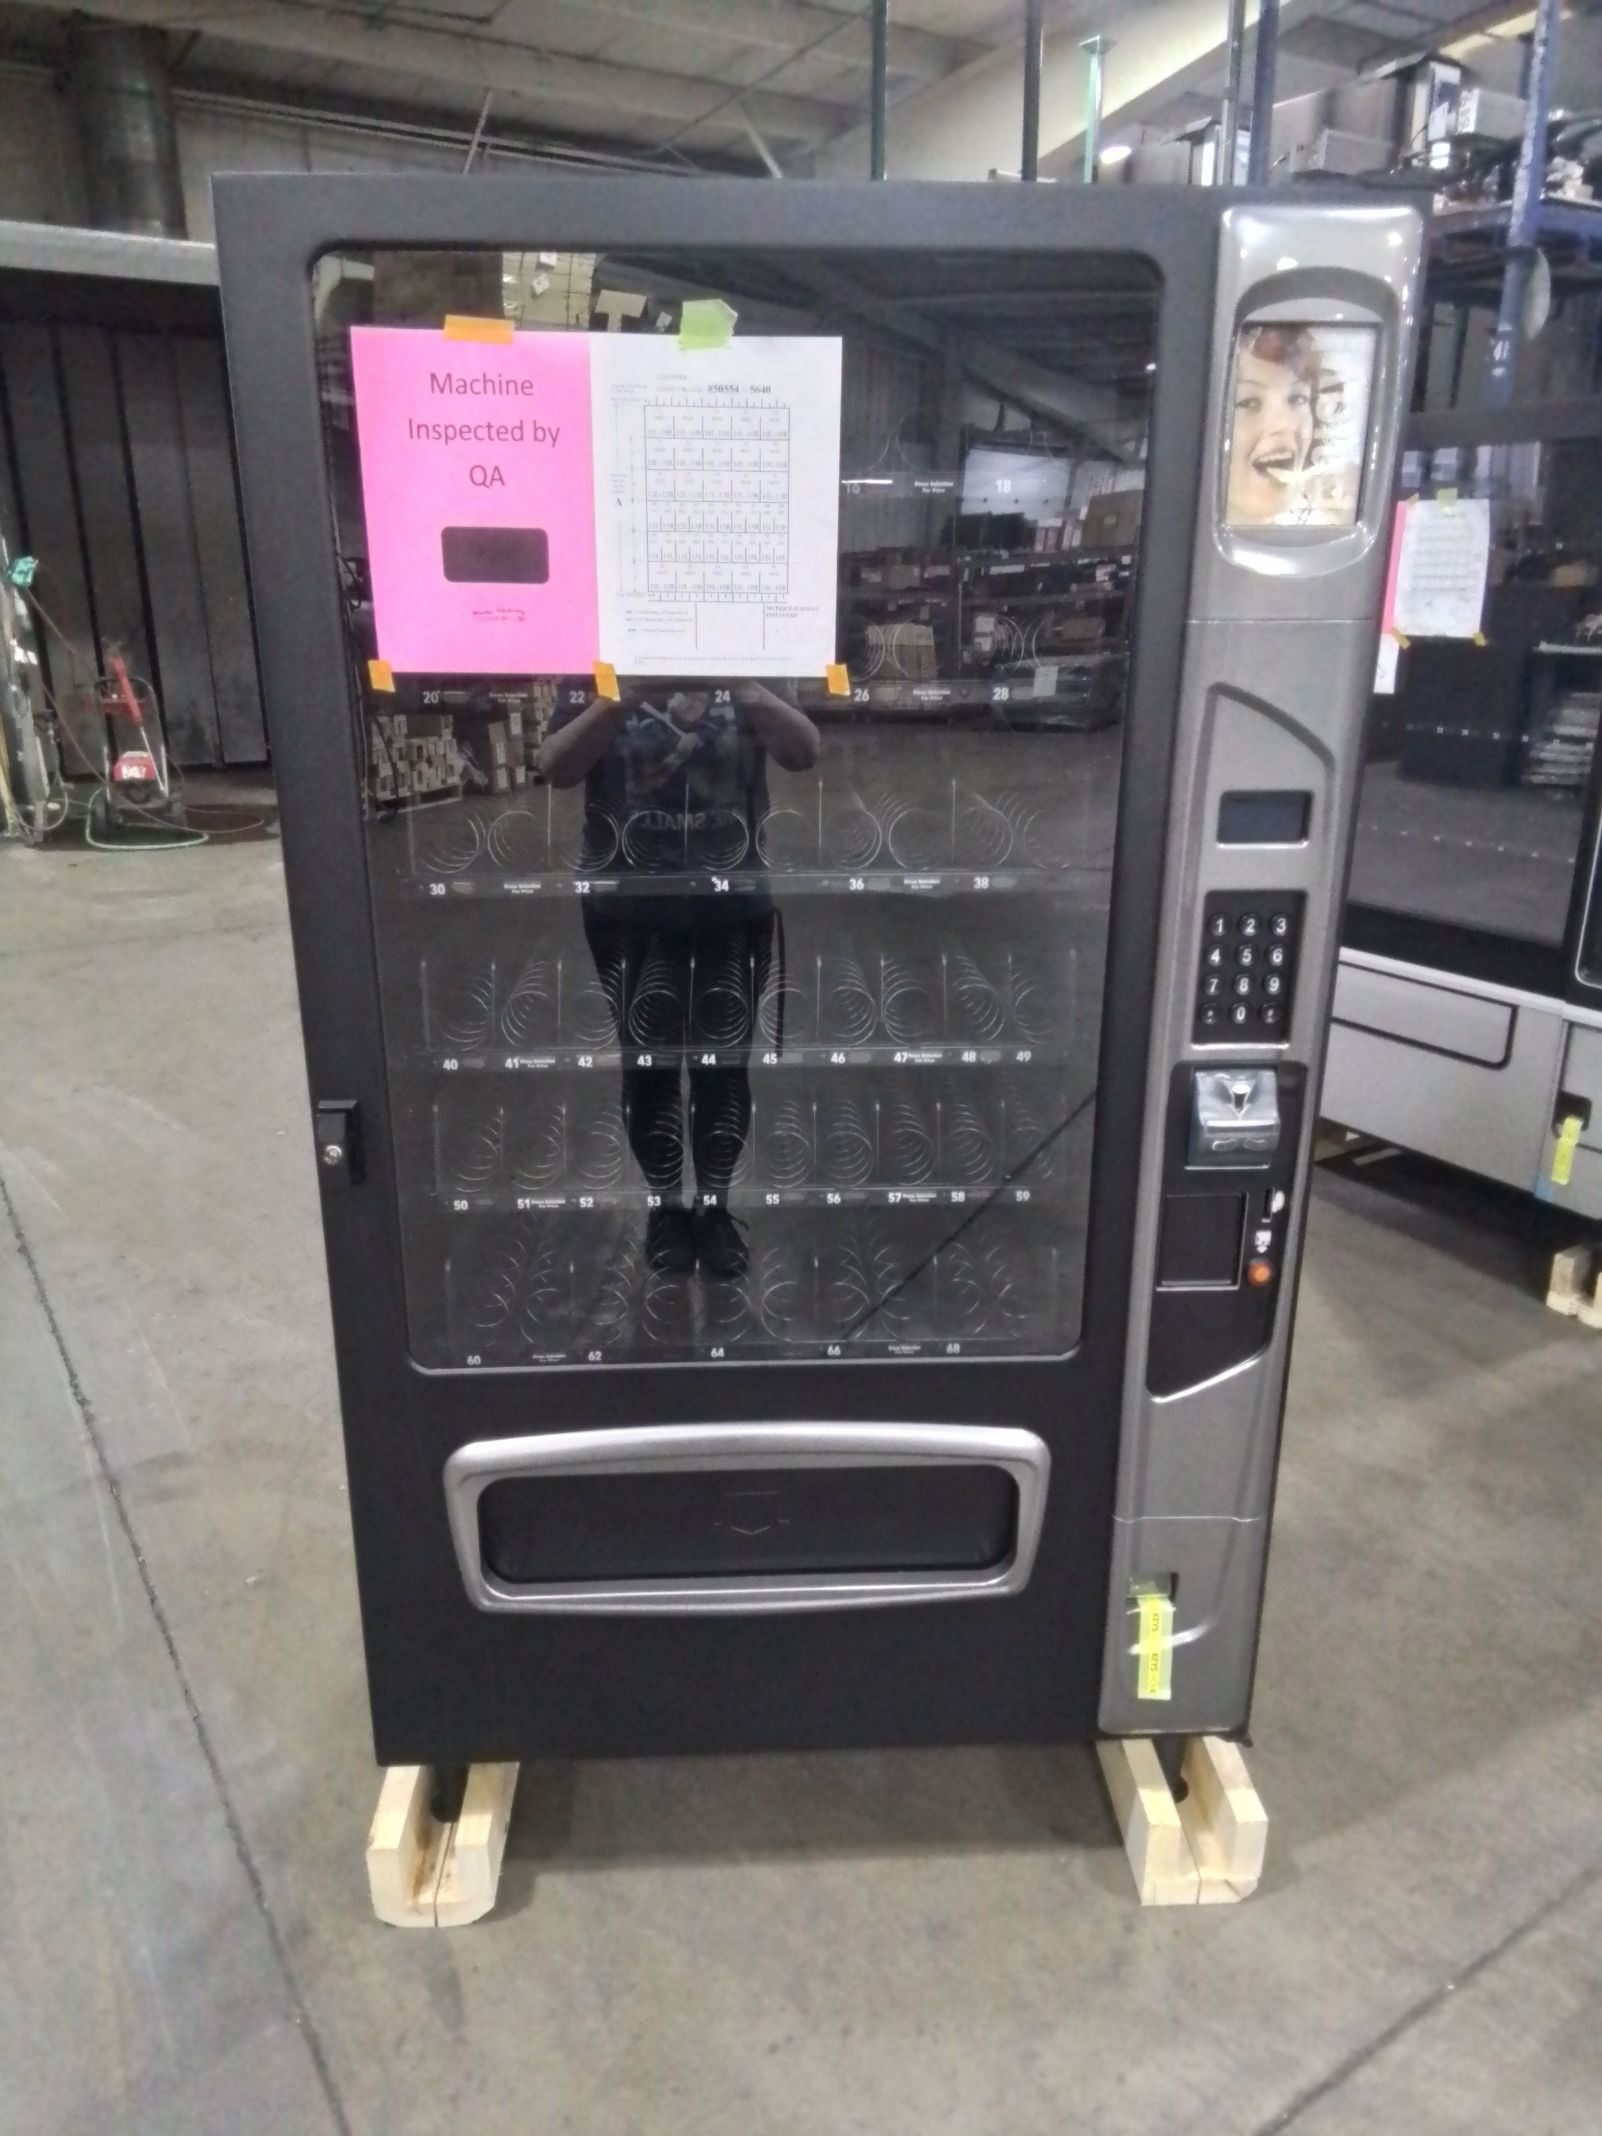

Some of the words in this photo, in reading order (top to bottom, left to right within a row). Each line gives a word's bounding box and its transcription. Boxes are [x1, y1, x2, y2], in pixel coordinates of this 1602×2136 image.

[430, 372, 534, 397] Machine
[749, 385, 771, 394] 5640
[408, 418, 524, 446] Inspected
[533, 419, 561, 448] by
[469, 465, 506, 489] QA
[996, 479, 1011, 493] 18
[423, 691, 438, 704] 20
[570, 691, 585, 703] 22
[715, 690, 730, 703] 24
[854, 688, 869, 701] 26
[993, 687, 1009, 700] 28
[575, 881, 590, 893] 32
[713, 878, 729, 891] 34
[850, 878, 864, 890] 36
[974, 877, 989, 889] 38
[430, 883, 445, 895] 30
[1217, 919, 1223, 935] 1
[1245, 919, 1255, 935] 2
[1276, 918, 1286, 935] 3
[1211, 949, 1220, 964] 4
[1242, 949, 1251, 965] 5
[1273, 949, 1282, 964] 6
[1210, 979, 1218, 994] 7
[1239, 978, 1248, 994] 8
[1269, 977, 1279, 993] 9
[1236, 1007, 1245, 1022] 0
[578, 1056, 592, 1067] 42
[637, 1055, 652, 1066] 43
[702, 1054, 716, 1065] 44
[763, 1053, 777, 1064] 45
[831, 1052, 845, 1063] 46
[894, 1052, 908, 1063] 47
[962, 1051, 976, 1062] 48
[1016, 1051, 1031, 1061] 49
[443, 1059, 458, 1070] 40
[505, 1057, 519, 1068] 41
[647, 1195, 661, 1207] 53
[704, 1195, 717, 1205] 54
[766, 1194, 779, 1204] 55
[827, 1193, 841, 1203] 56
[888, 1192, 901, 1202] 57
[951, 1191, 965, 1202] 58
[1016, 1190, 1030, 1201] 59
[454, 1200, 468, 1210] 50
[518, 1198, 530, 1209] 51
[580, 1197, 594, 1207] 52
[711, 1348, 724, 1357] 64
[828, 1345, 841, 1355] 66
[947, 1343, 960, 1353] 68
[467, 1355, 481, 1365] 60
[588, 1351, 601, 1361] 62
[1151, 1613, 1160, 1632] KEYS
[1150, 1653, 1159, 1672] KEYS
